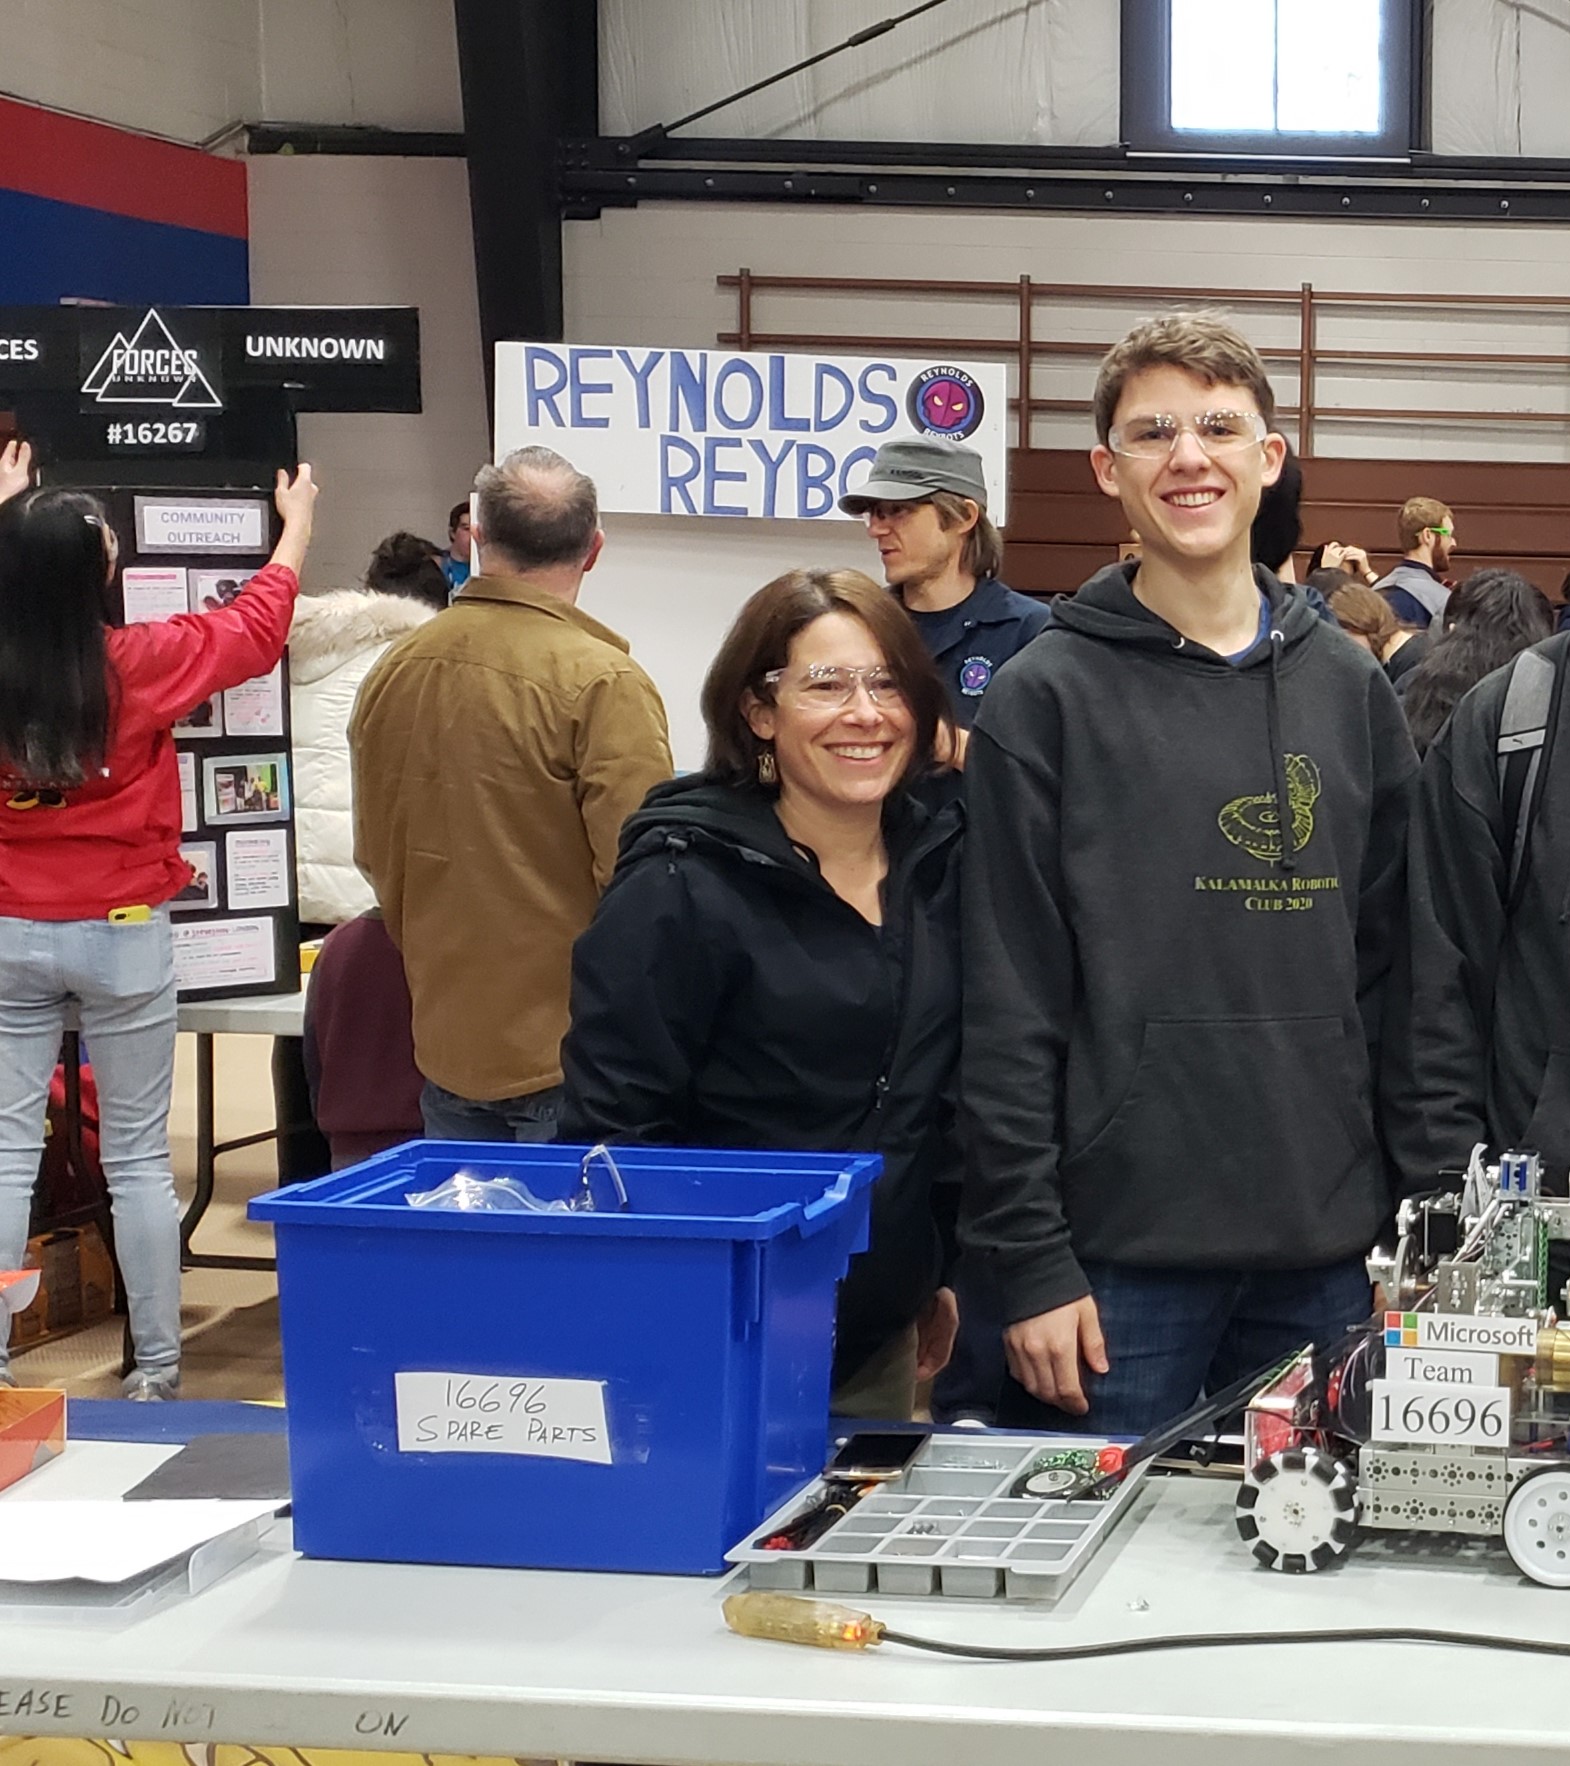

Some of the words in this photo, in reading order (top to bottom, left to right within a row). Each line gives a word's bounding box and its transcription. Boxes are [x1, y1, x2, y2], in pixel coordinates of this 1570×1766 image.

[245, 334, 385, 360] UNKNOWN
[112, 348, 198, 375] FORCES
[524, 346, 898, 433] REYNOLDS
[920, 367, 974, 388] REYNOLDS
[106, 422, 198, 445] #16267
[160, 511, 246, 524] COMMUNITY
[167, 531, 241, 544] OUTREACH
[1194, 876, 1289, 891] KALAMALKA
[1244, 896, 1284, 911] CLUB
[1285, 896, 1313, 911] 2020
[1425, 1319, 1535, 1347] Microsoft
[1403, 1356, 1474, 1384] Team
[446, 1379, 547, 1414] 16696
[1379, 1394, 1503, 1437] 16696
[416, 1415, 504, 1442] SPARE
[527, 1417, 597, 1444] PARTS
[355, 1709, 410, 1736] ON
